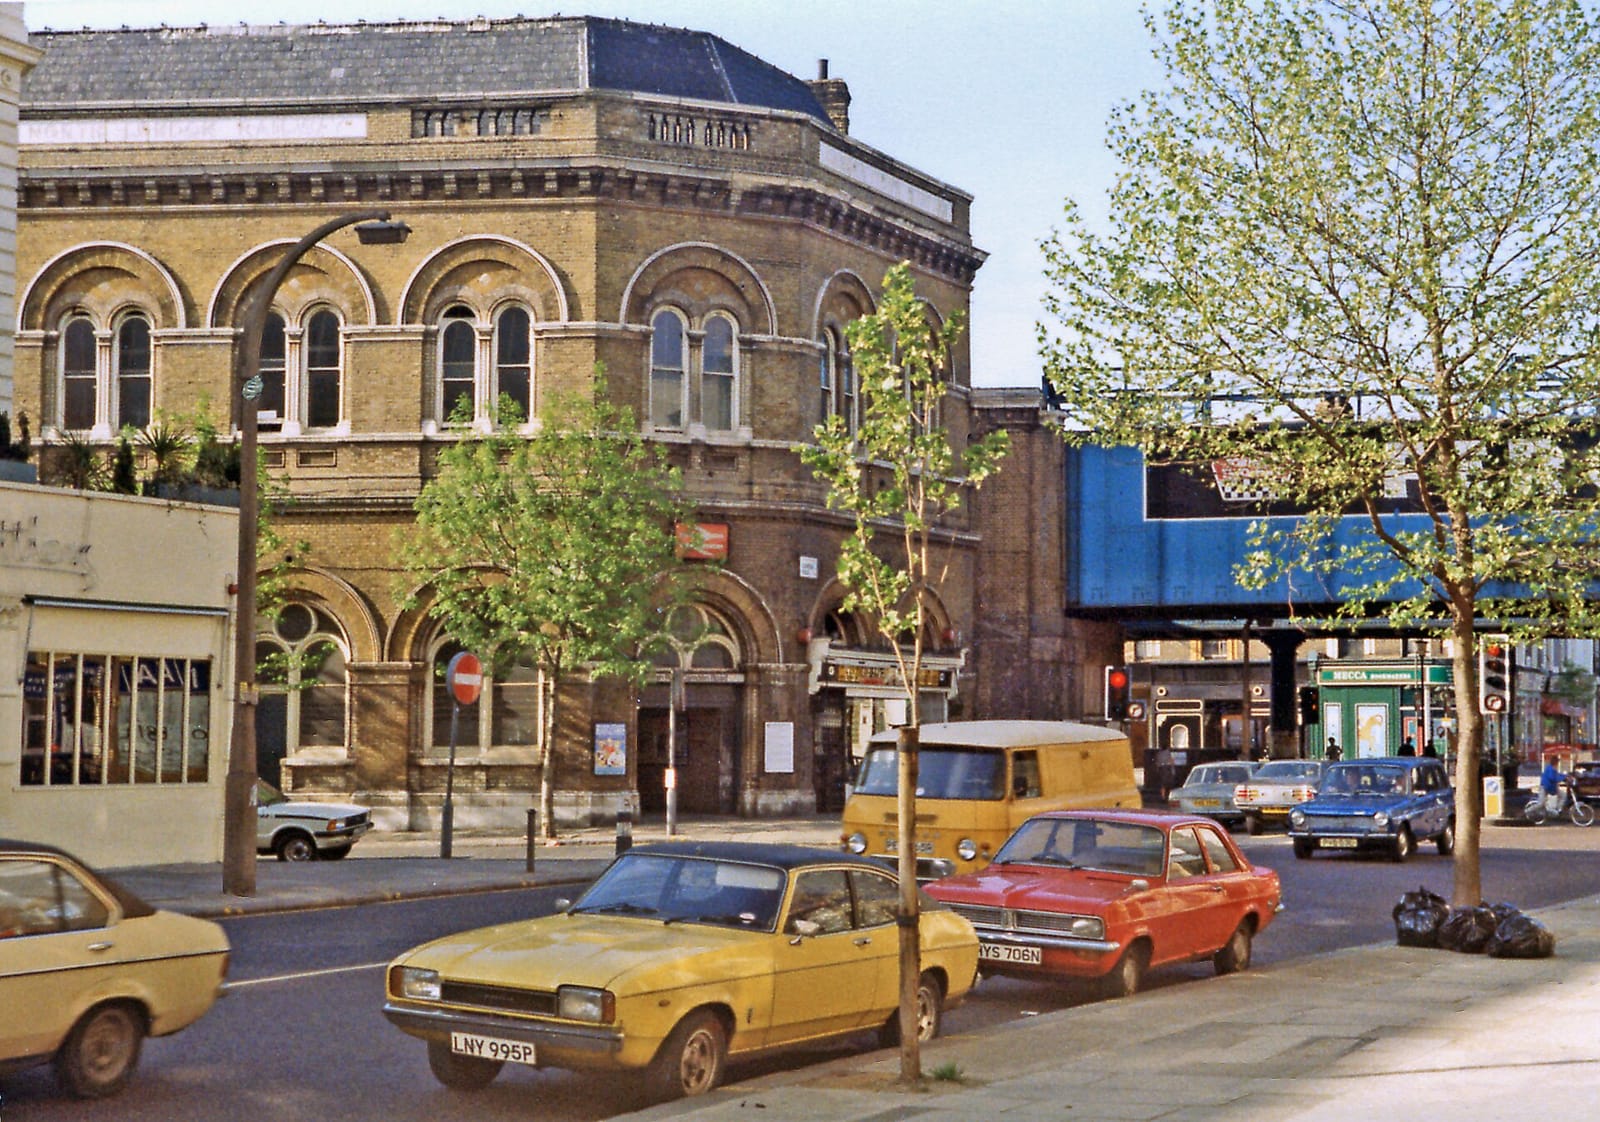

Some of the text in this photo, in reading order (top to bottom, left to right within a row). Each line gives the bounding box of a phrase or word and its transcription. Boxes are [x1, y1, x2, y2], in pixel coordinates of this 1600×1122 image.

[1333, 671, 1367, 680] MECCA
[1004, 947, 1040, 962] 706N
[454, 1036, 532, 1062] LNY 995P
